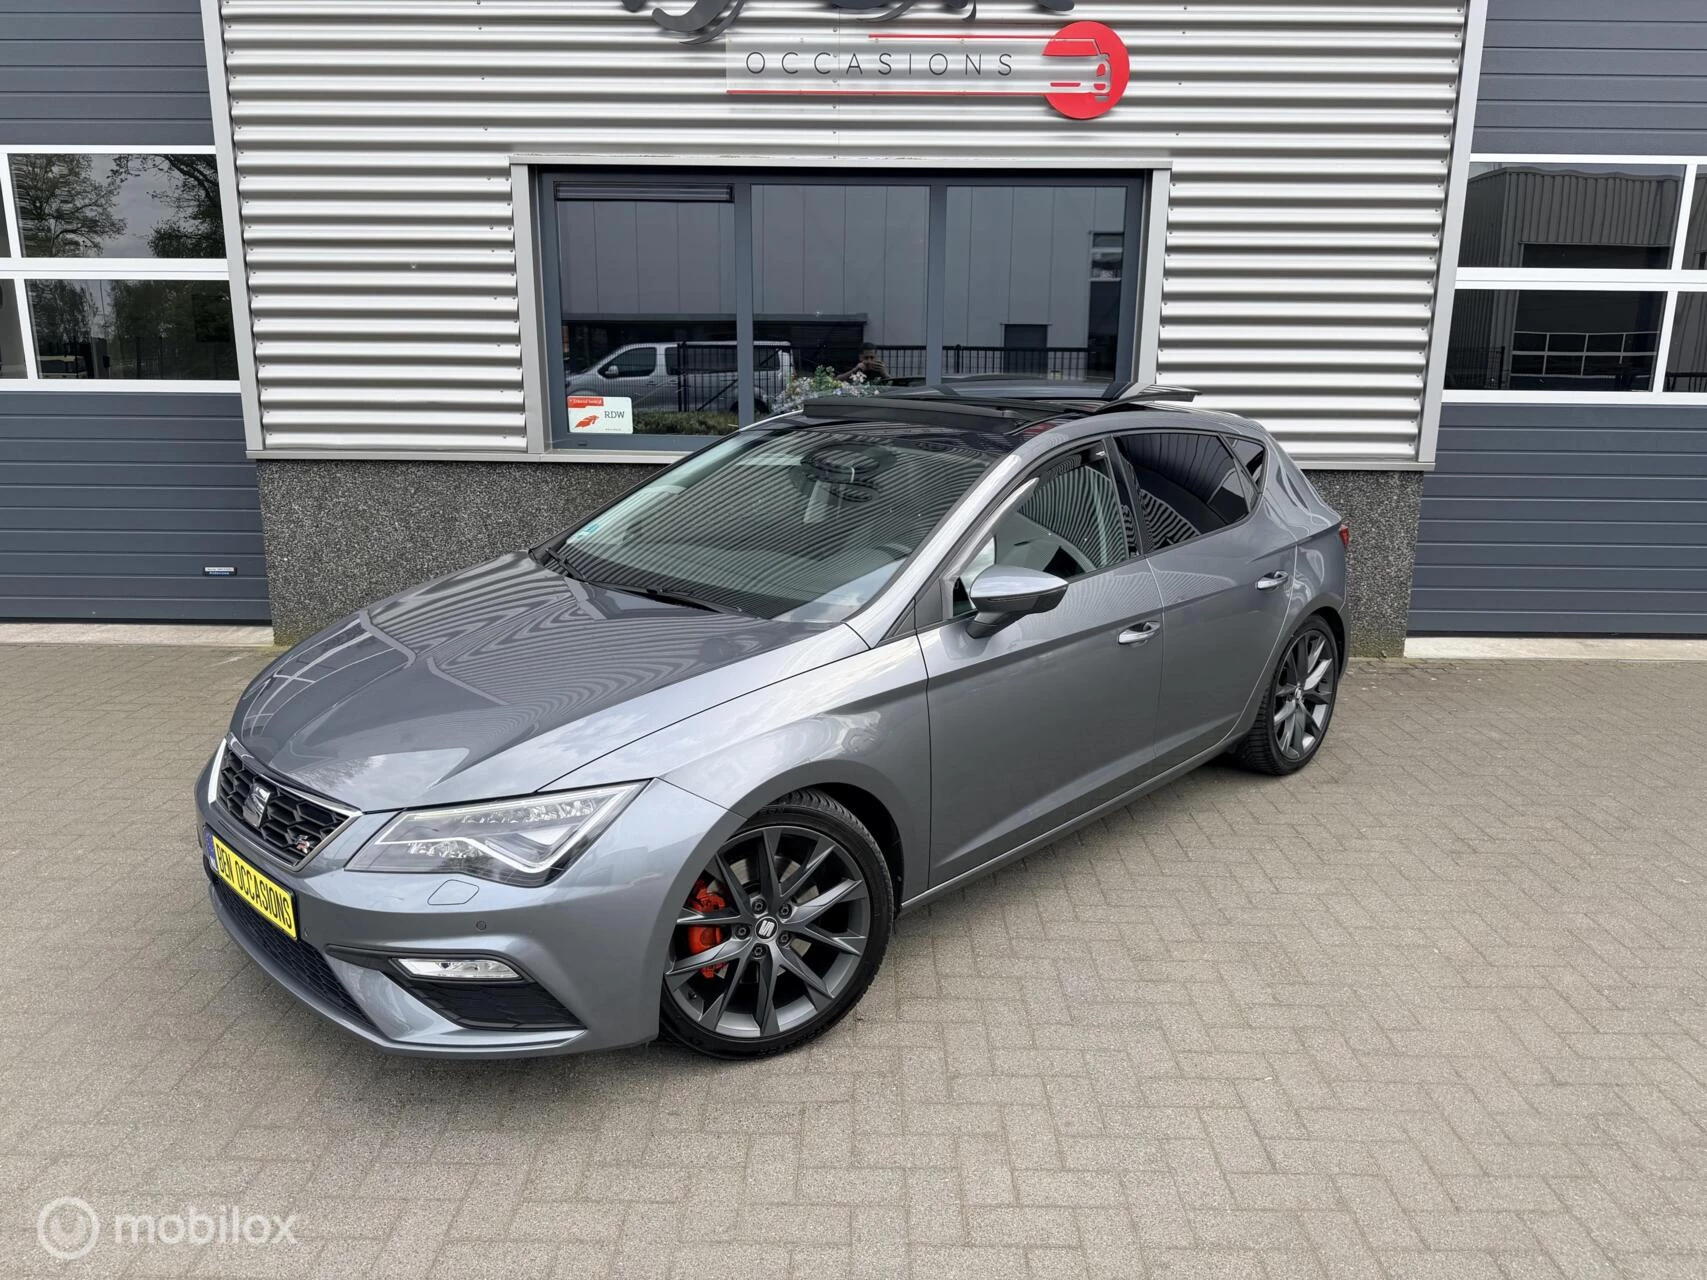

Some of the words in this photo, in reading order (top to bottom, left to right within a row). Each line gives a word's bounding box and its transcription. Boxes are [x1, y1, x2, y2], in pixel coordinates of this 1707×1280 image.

[745, 51, 1013, 77] OCCASIONS
[604, 410, 625, 419] RDW
[235, 860, 293, 930] OCCASIONS
